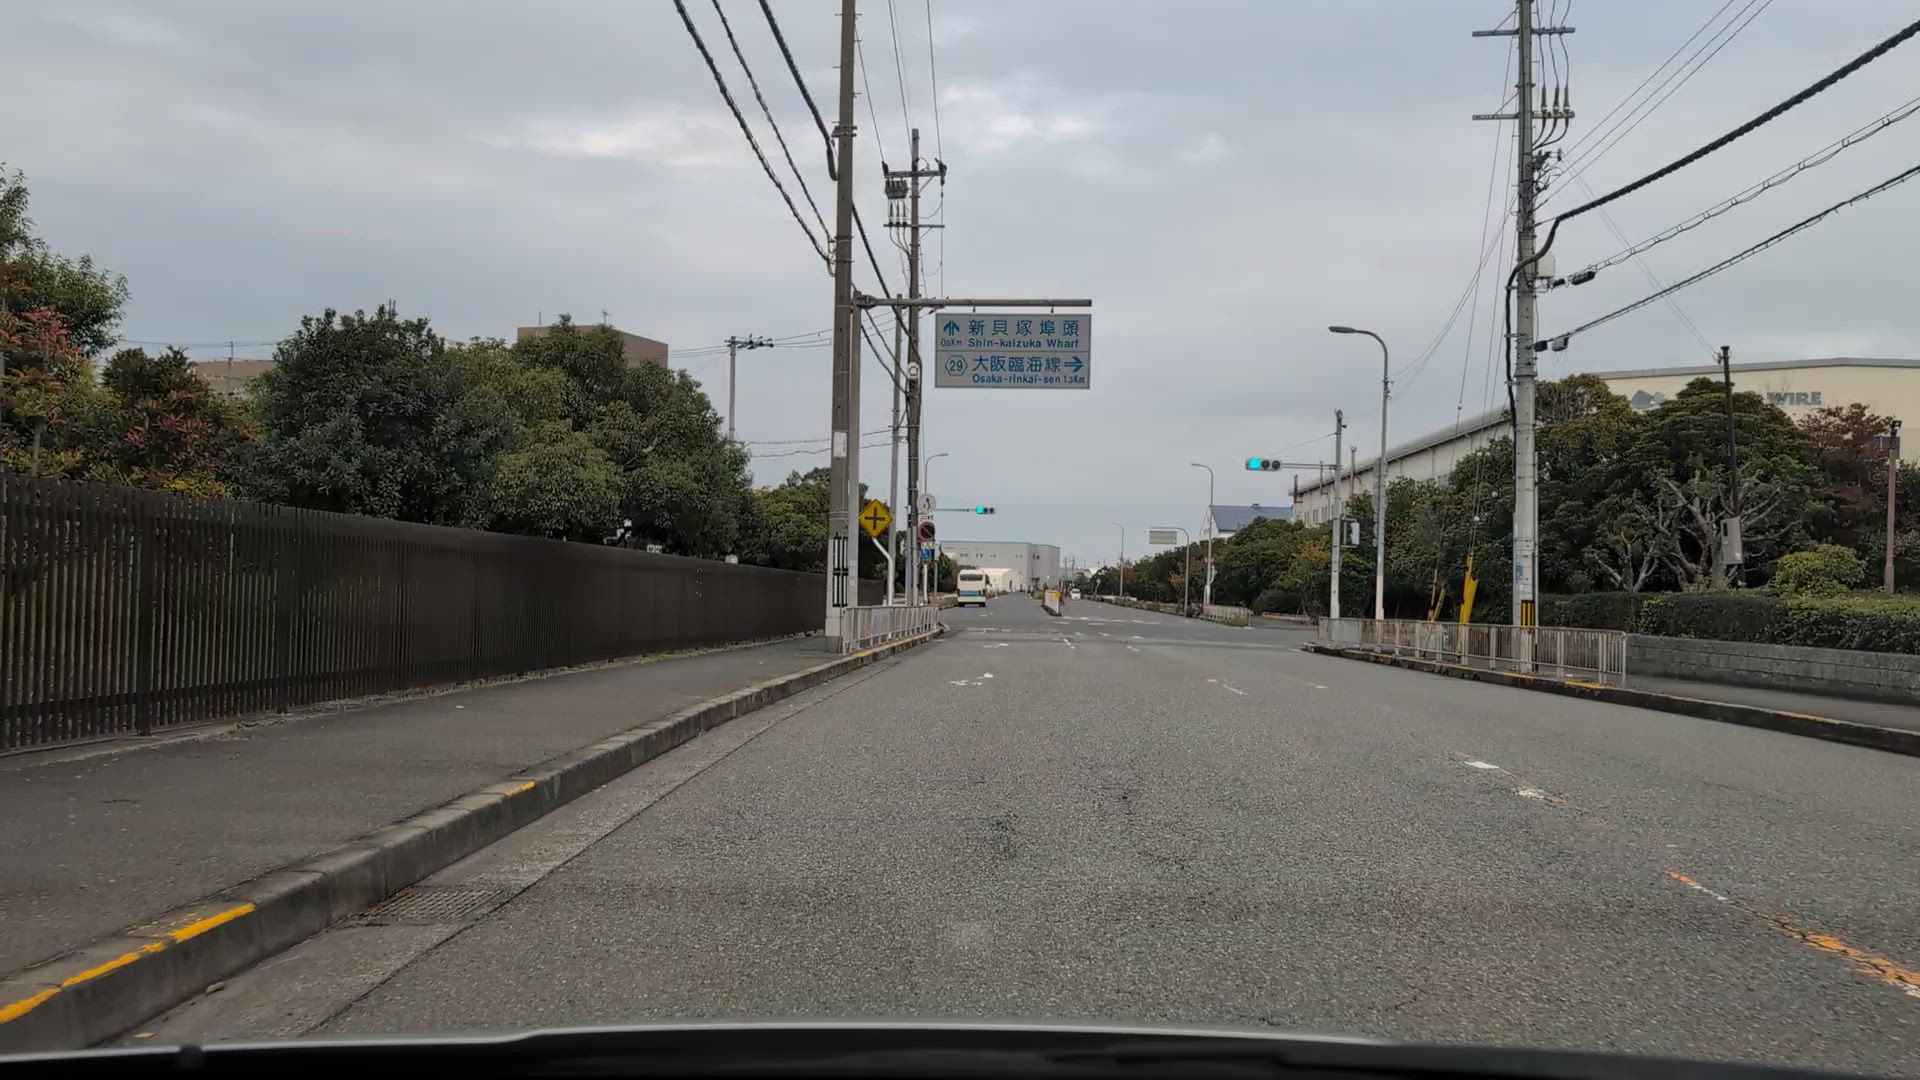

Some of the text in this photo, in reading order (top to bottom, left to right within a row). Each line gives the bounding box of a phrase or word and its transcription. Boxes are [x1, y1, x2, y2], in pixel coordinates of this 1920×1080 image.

[968, 319, 1079, 337] 新貝塚埠頭
[968, 338, 1042, 348] Shin-kaizuka
[1046, 338, 1079, 348] Wharf
[949, 355, 1061, 373] 29 大阪臨海線
[972, 373, 1061, 384] Osaka-rinkai-sen
[1766, 391, 1821, 405] WIRE
